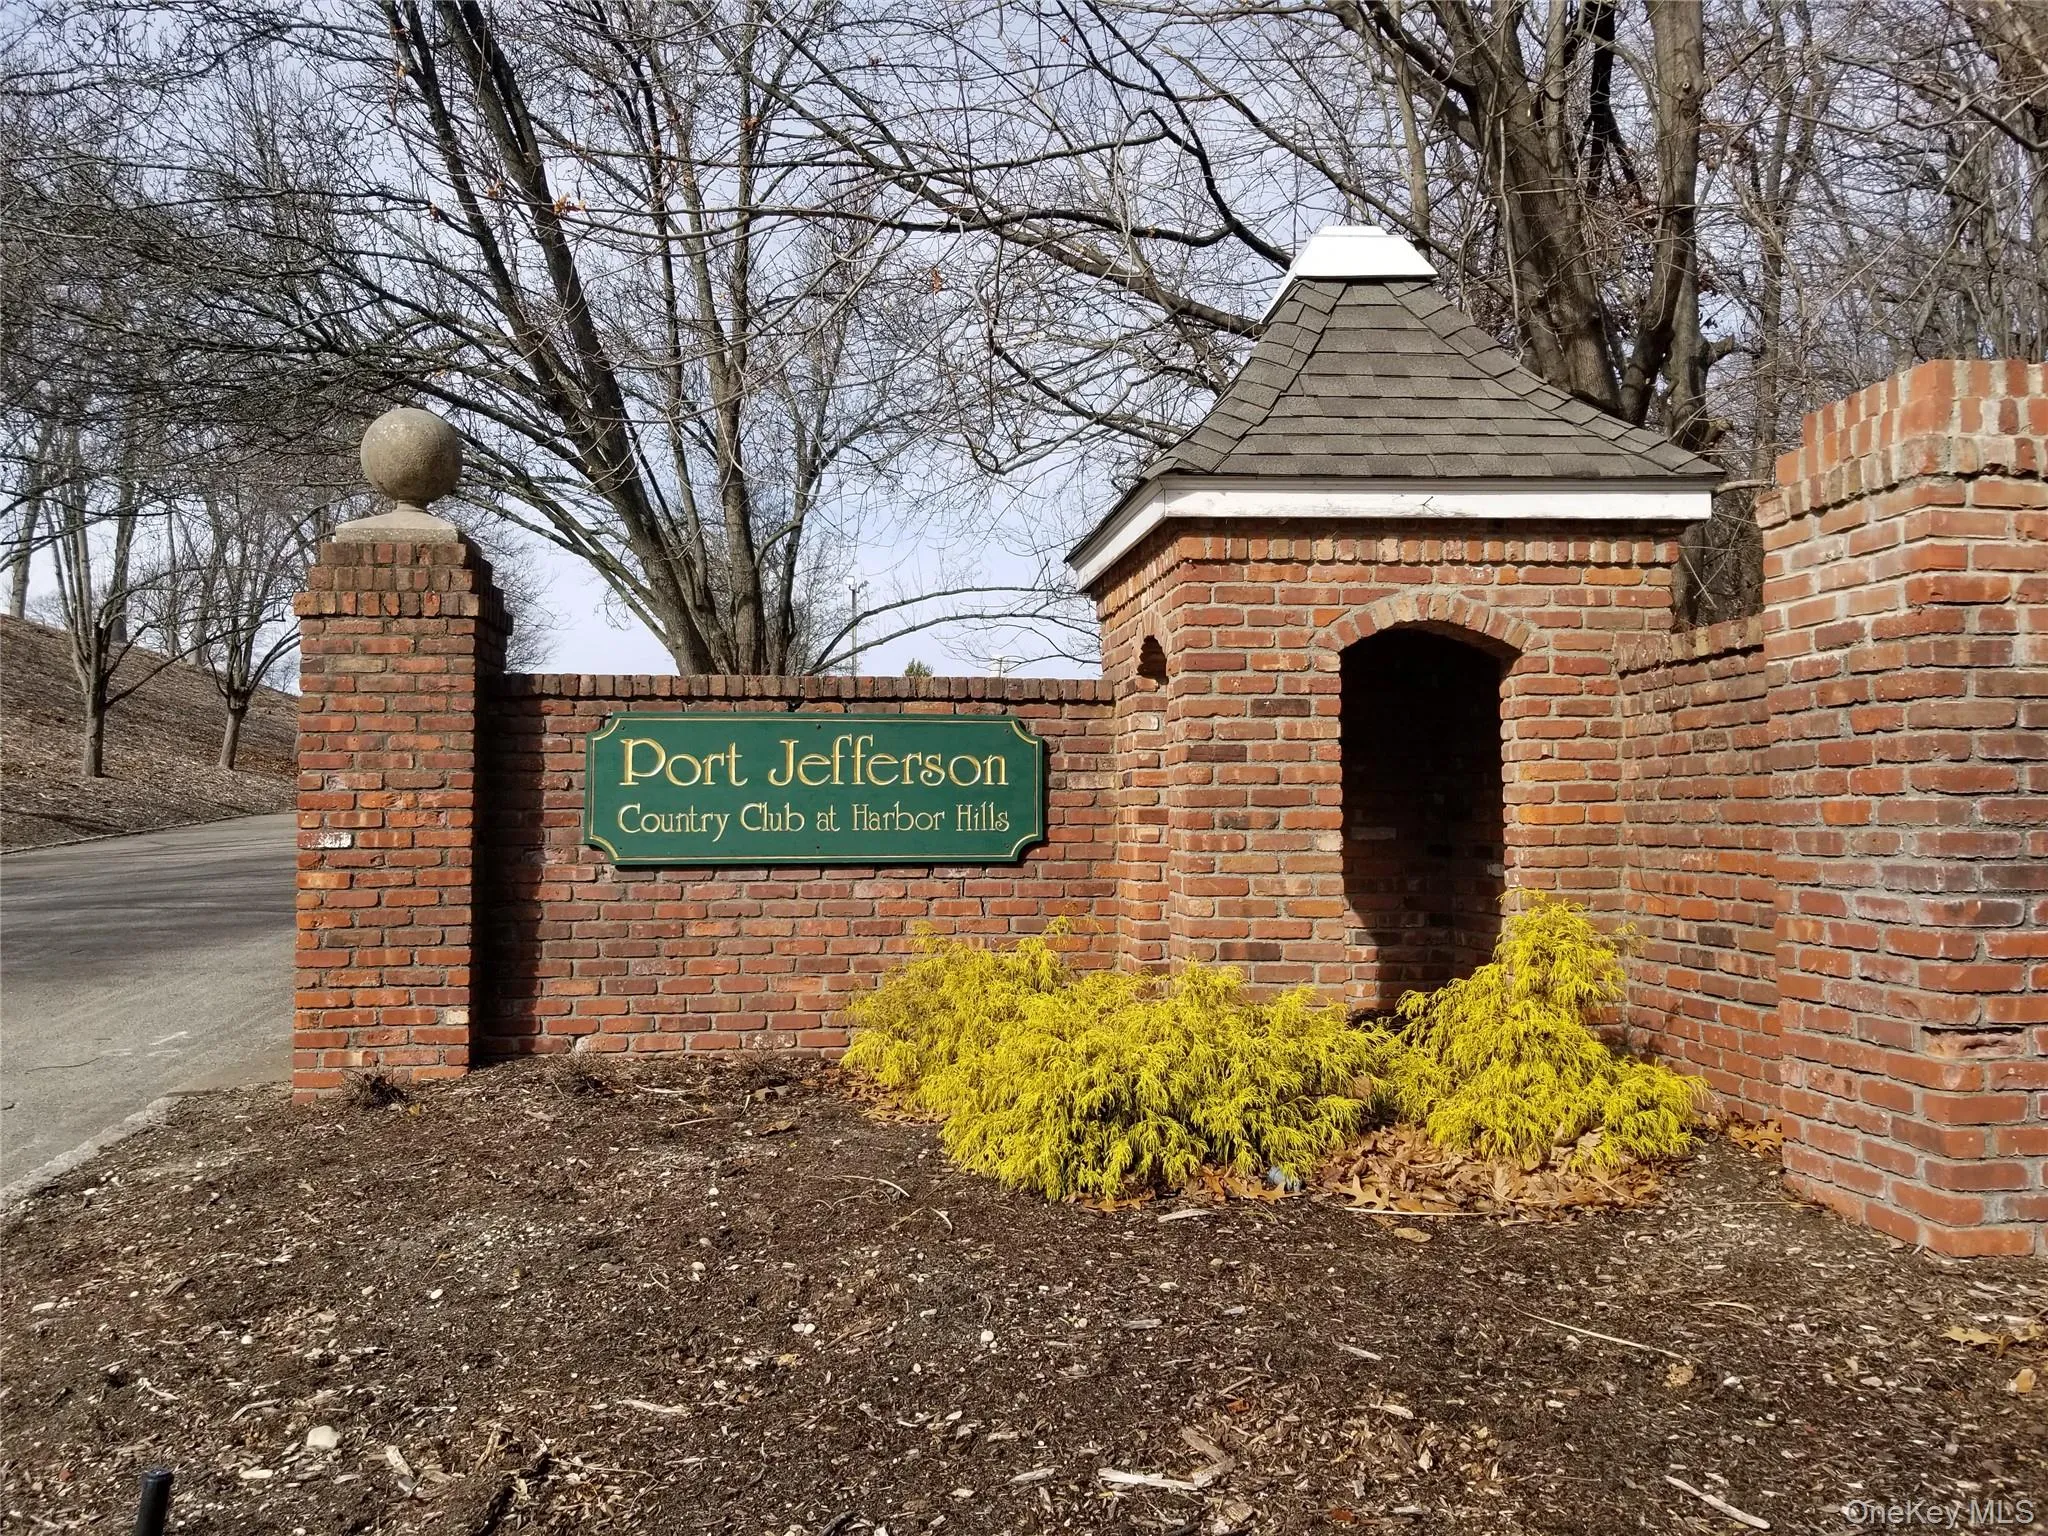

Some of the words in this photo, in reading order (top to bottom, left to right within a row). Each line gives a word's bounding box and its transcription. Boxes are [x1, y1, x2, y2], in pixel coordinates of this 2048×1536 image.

[619, 737, 749, 787] Port
[767, 733, 1009, 787] Jefferson
[617, 802, 730, 843] Country
[739, 801, 805, 833] Club
[815, 806, 841, 833] at
[851, 801, 945, 832] Harbor
[955, 801, 1010, 833] Hills
